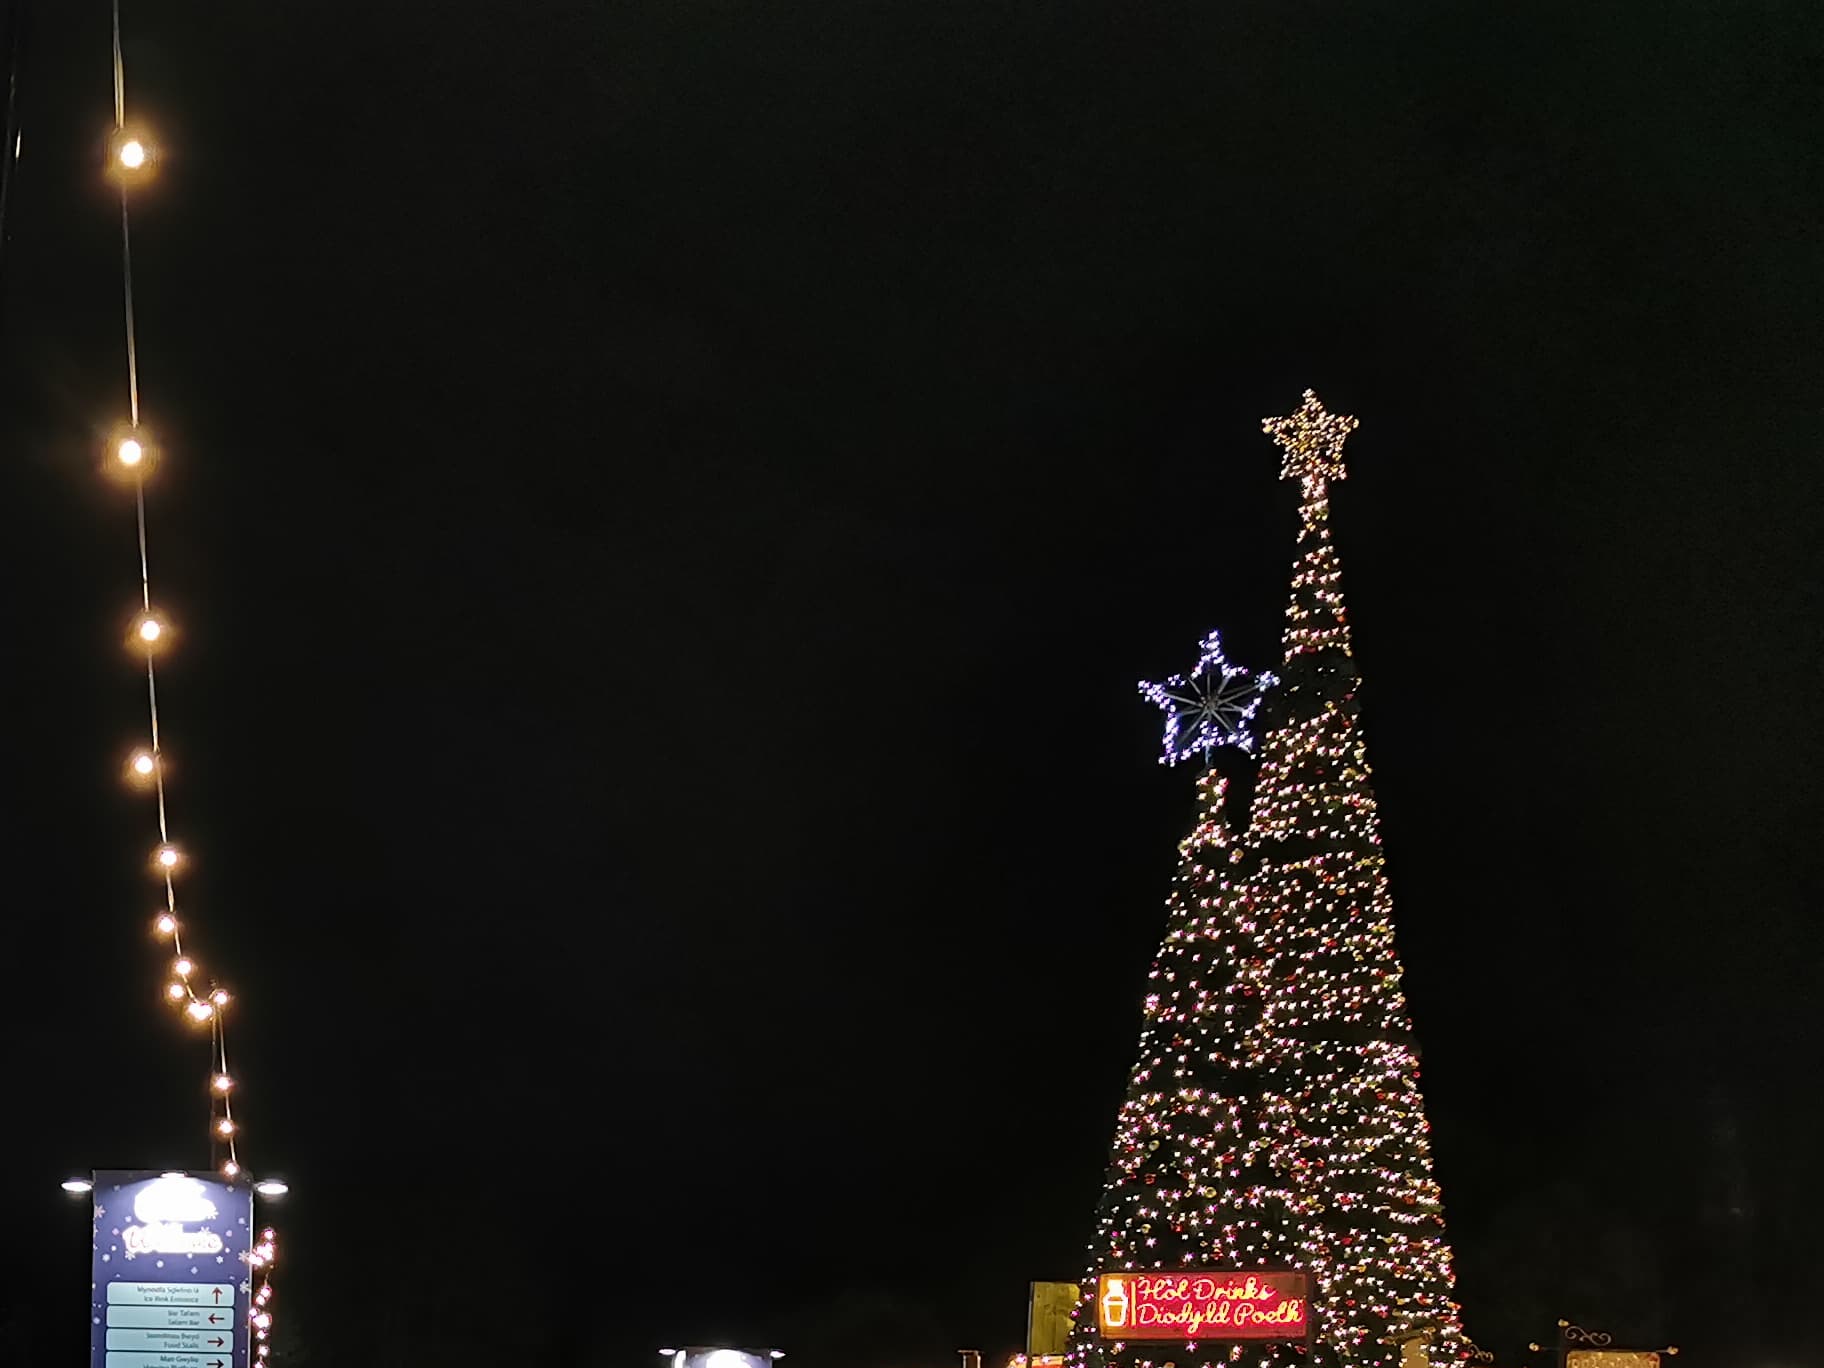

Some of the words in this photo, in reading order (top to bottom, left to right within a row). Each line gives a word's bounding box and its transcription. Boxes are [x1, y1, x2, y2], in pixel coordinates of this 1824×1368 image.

[1137, 1276, 1190, 1300] Hot
[1192, 1276, 1276, 1300] Drinks
[1137, 1301, 1229, 1333] Diodydd
[1234, 1298, 1304, 1326] Poeth
